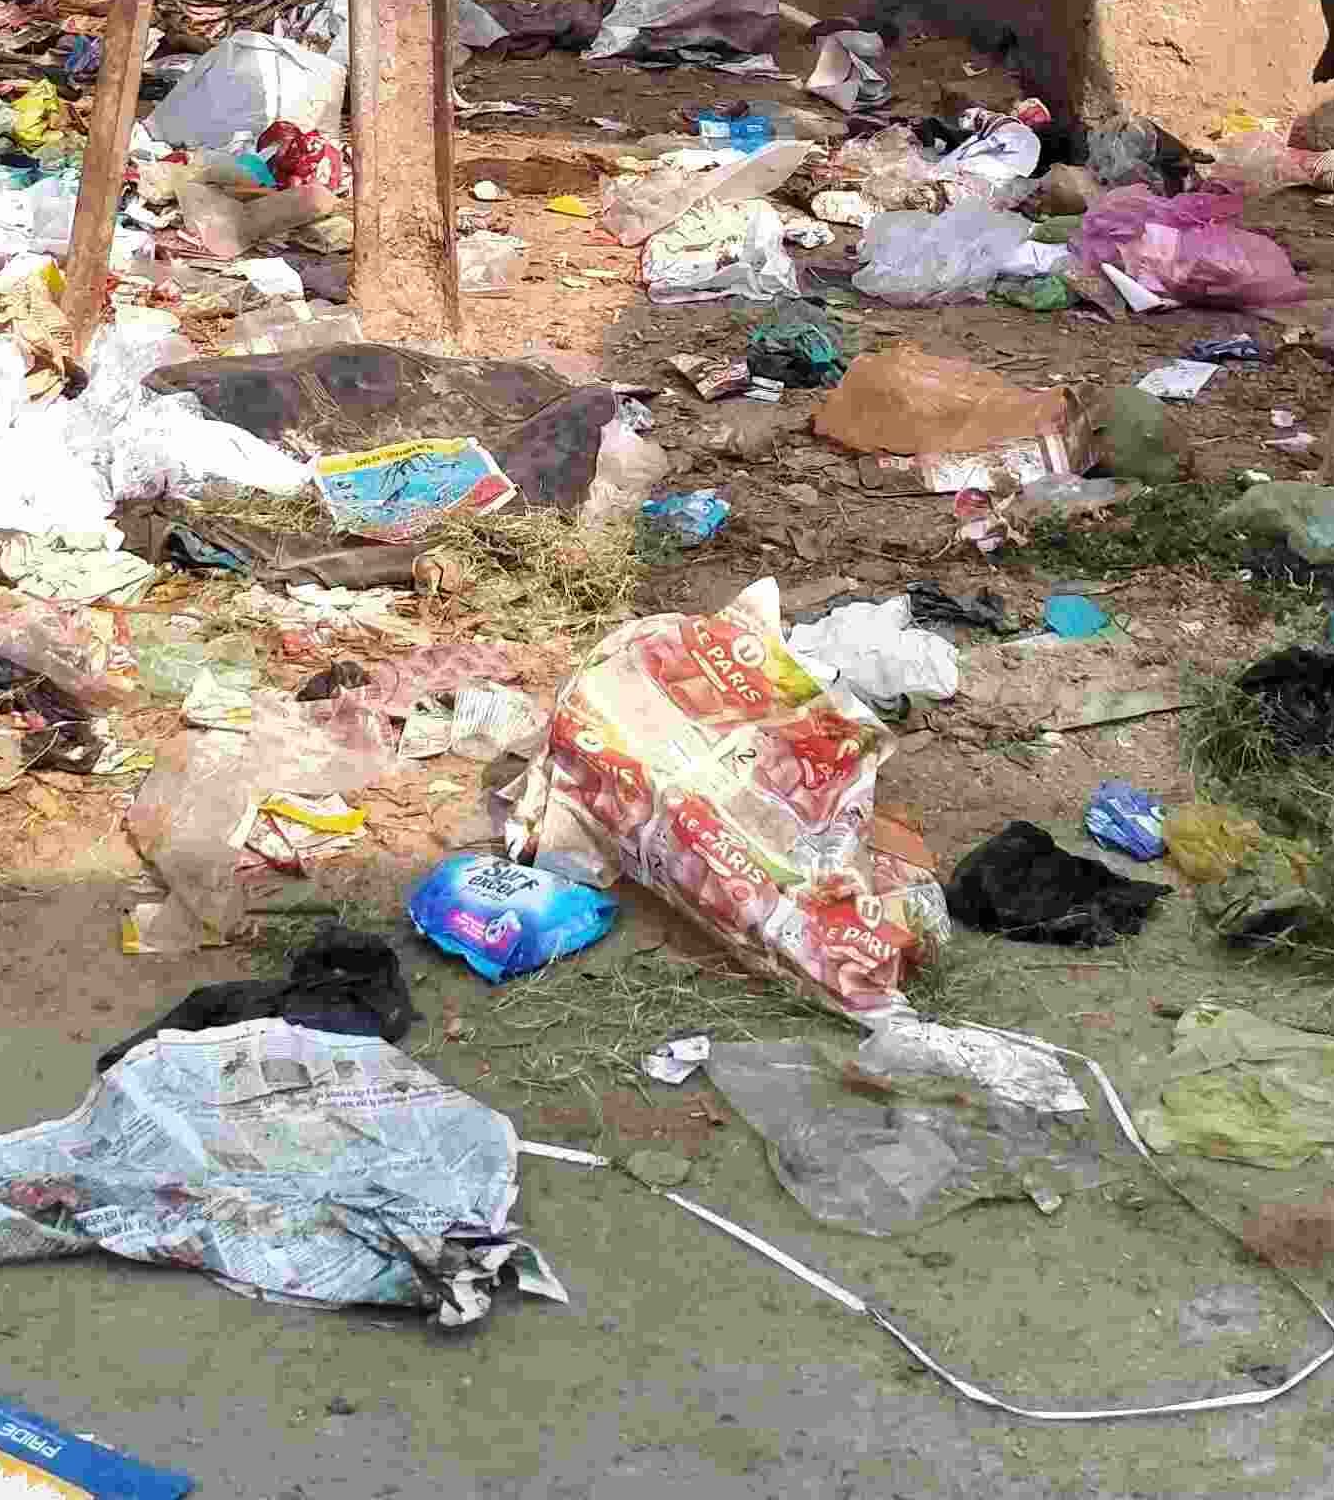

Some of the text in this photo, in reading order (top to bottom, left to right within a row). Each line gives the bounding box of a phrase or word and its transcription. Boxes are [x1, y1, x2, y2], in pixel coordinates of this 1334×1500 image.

[693, 619, 713, 646] LE
[706, 646, 764, 704] PARIS
[677, 811, 768, 885] LE PARIS
[467, 874, 518, 897] excel
[482, 860, 541, 892] Surf
